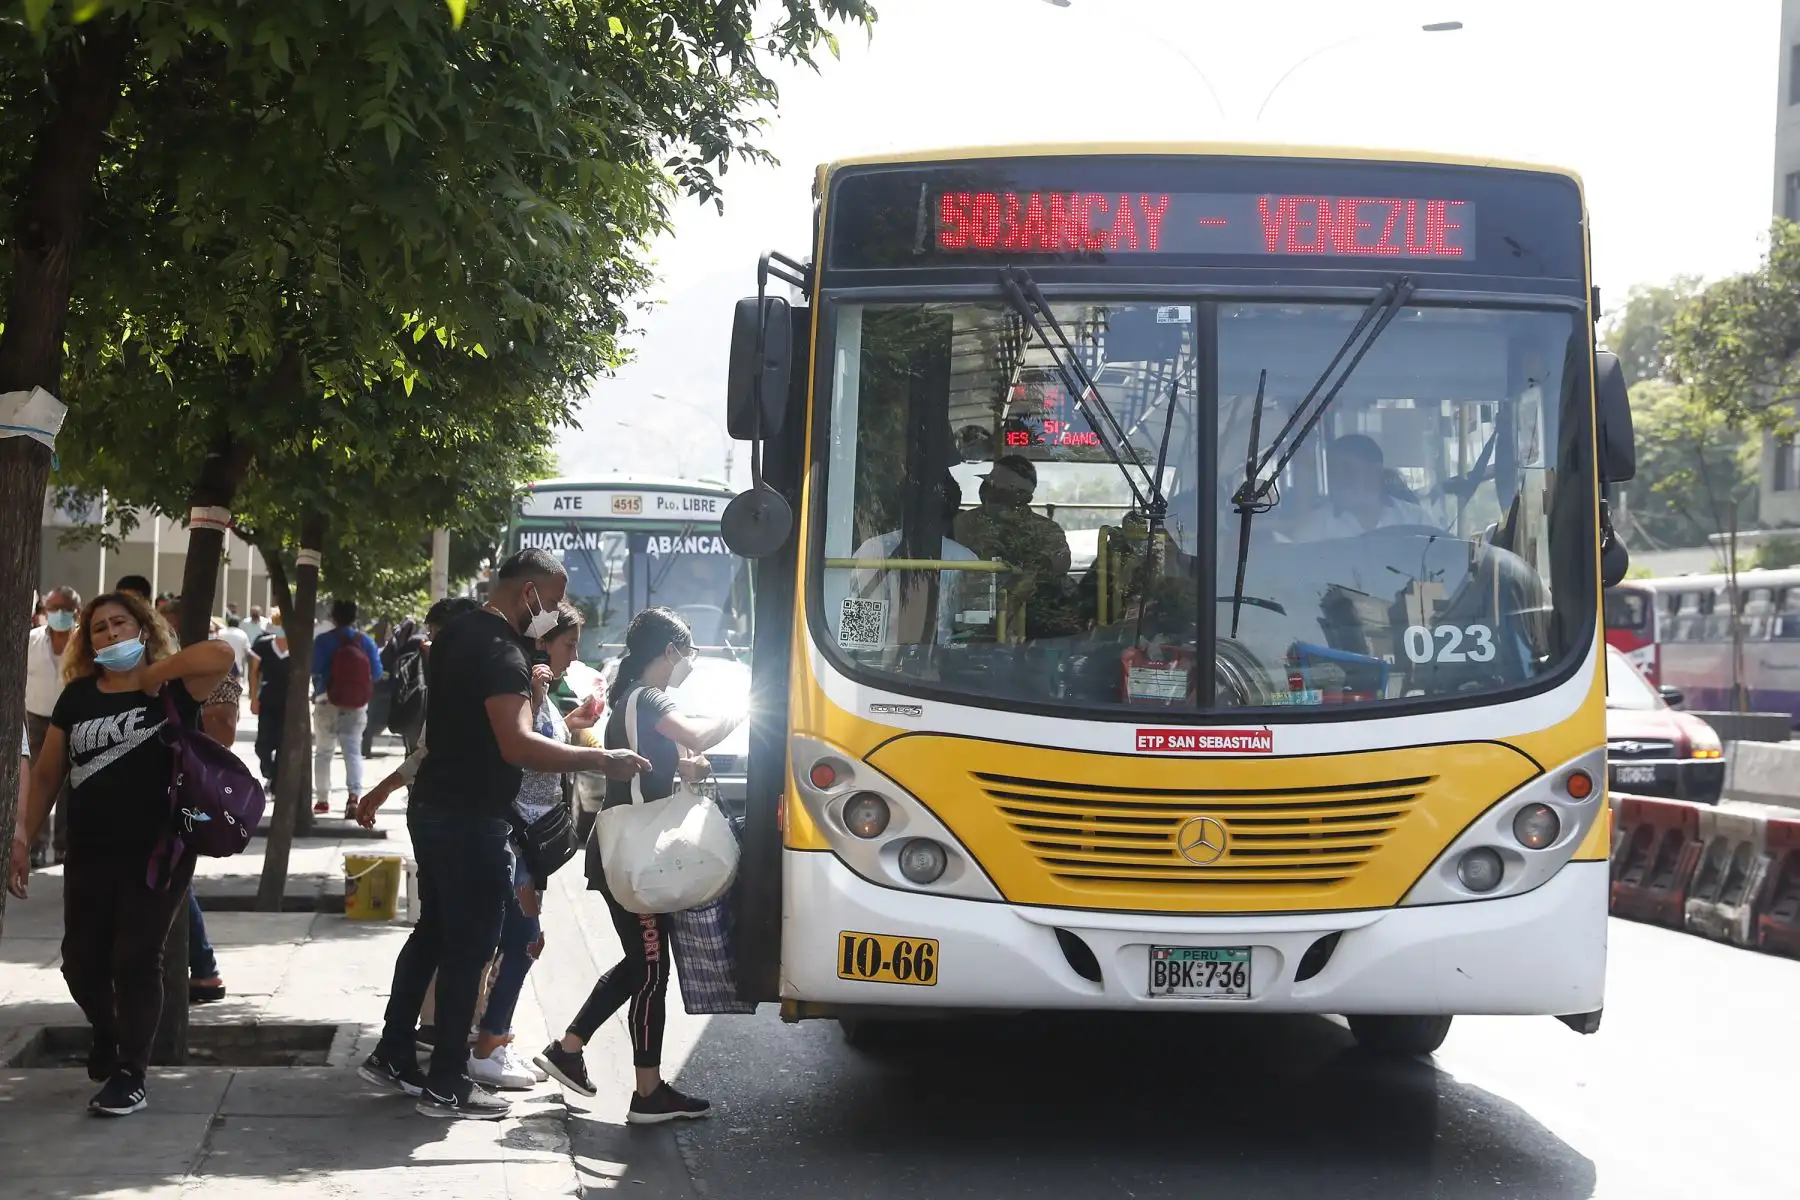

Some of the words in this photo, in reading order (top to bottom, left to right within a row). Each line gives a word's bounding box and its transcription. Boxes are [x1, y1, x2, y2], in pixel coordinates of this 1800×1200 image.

[1258, 197, 1465, 256] VENEZUE
[553, 496, 583, 510] ATE
[613, 499, 640, 511] 4515
[683, 498, 716, 513] LIBRE
[1403, 624, 1496, 664] 023
[70, 706, 147, 757] NIKE
[1138, 735, 1165, 748] ETP
[1168, 735, 1195, 748] SAN
[1198, 731, 1271, 749] SEBASTIÁN
[1183, 950, 1218, 960] PERU
[1154, 960, 1246, 988] BBK-736
